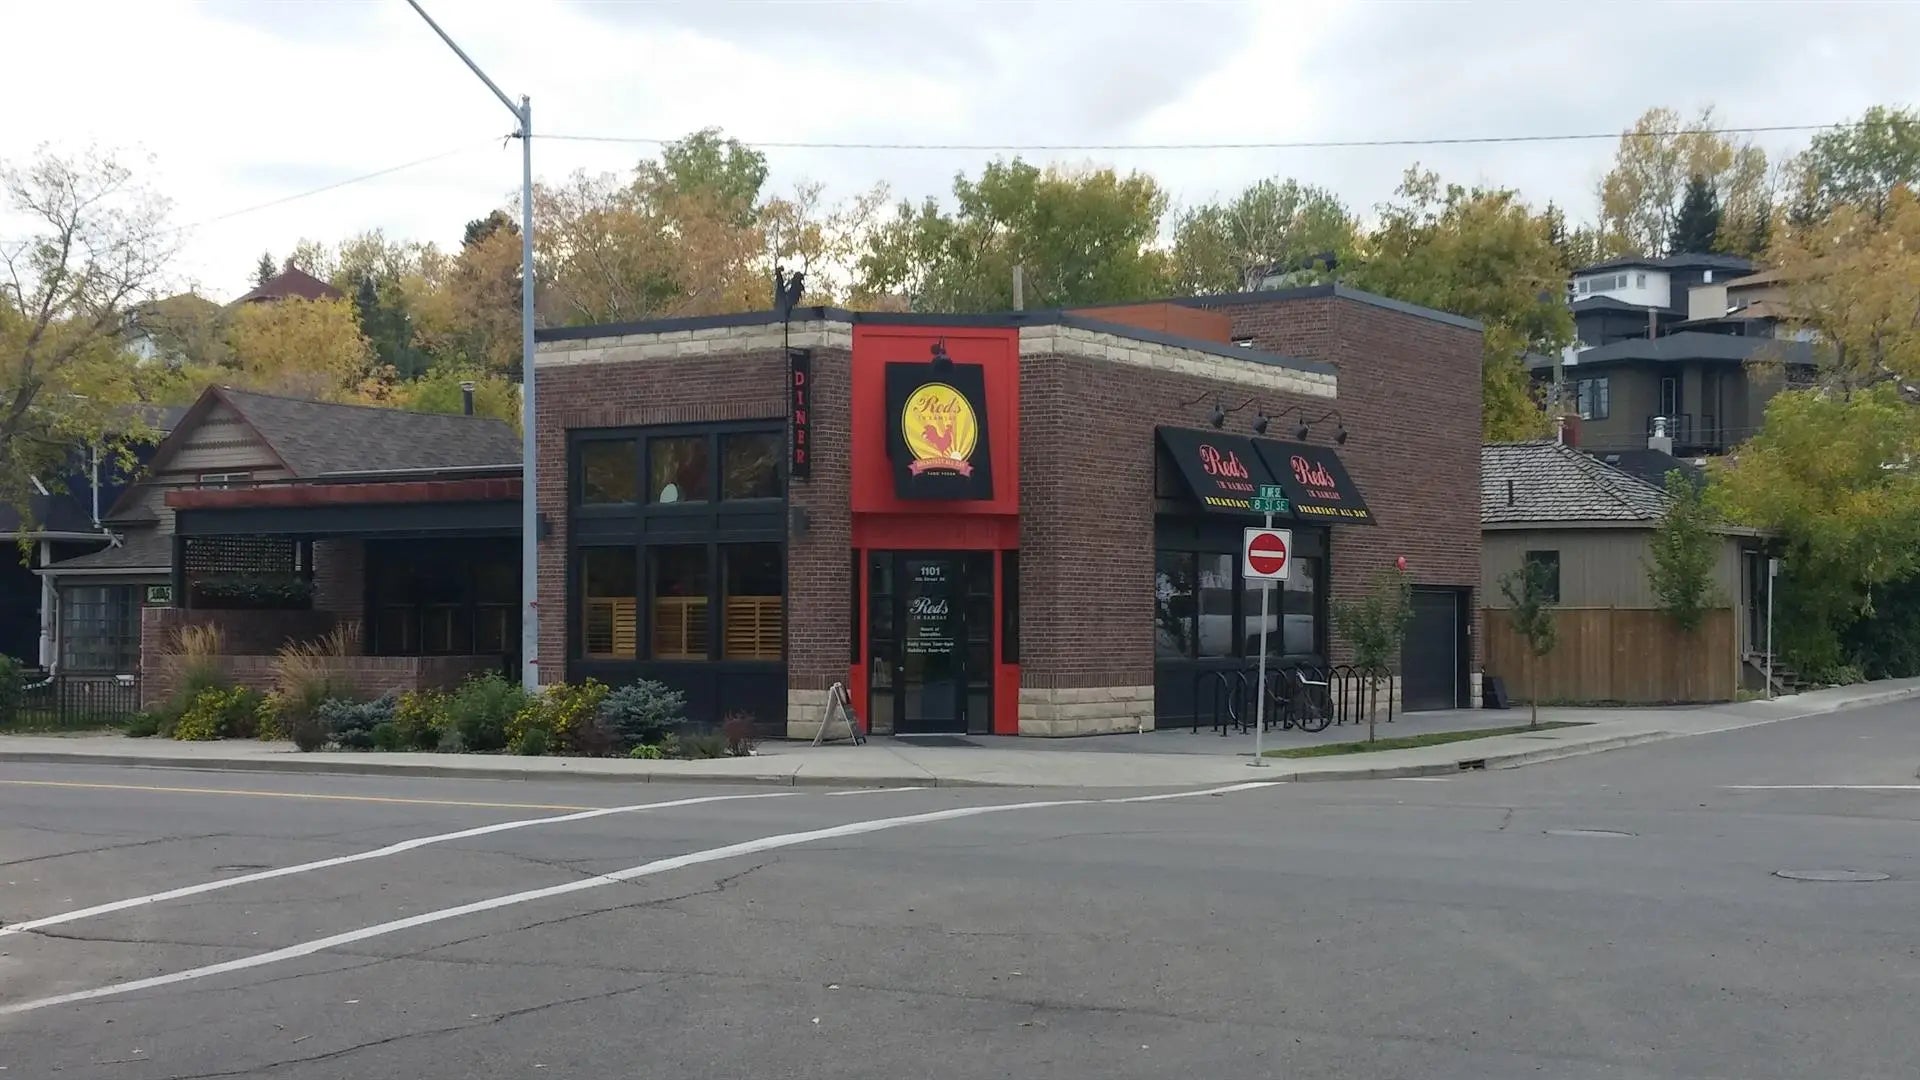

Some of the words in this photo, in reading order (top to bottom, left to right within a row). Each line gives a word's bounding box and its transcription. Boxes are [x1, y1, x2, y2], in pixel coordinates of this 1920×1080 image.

[913, 396, 961, 414] Red's
[795, 371, 806, 463] DINER
[1200, 445, 1248, 479] Red's
[1291, 455, 1335, 489] Red's
[1216, 480, 1226, 489] IN
[1204, 496, 1250, 508] BREAKFAST
[1254, 500, 1261, 510] 8
[1264, 500, 1273, 511] ST
[1276, 500, 1286, 511] SE
[1298, 504, 1339, 515] BREAKFAST
[1339, 508, 1353, 517] ALL
[1352, 509, 1368, 518] DAY
[920, 566, 940, 576] 1101
